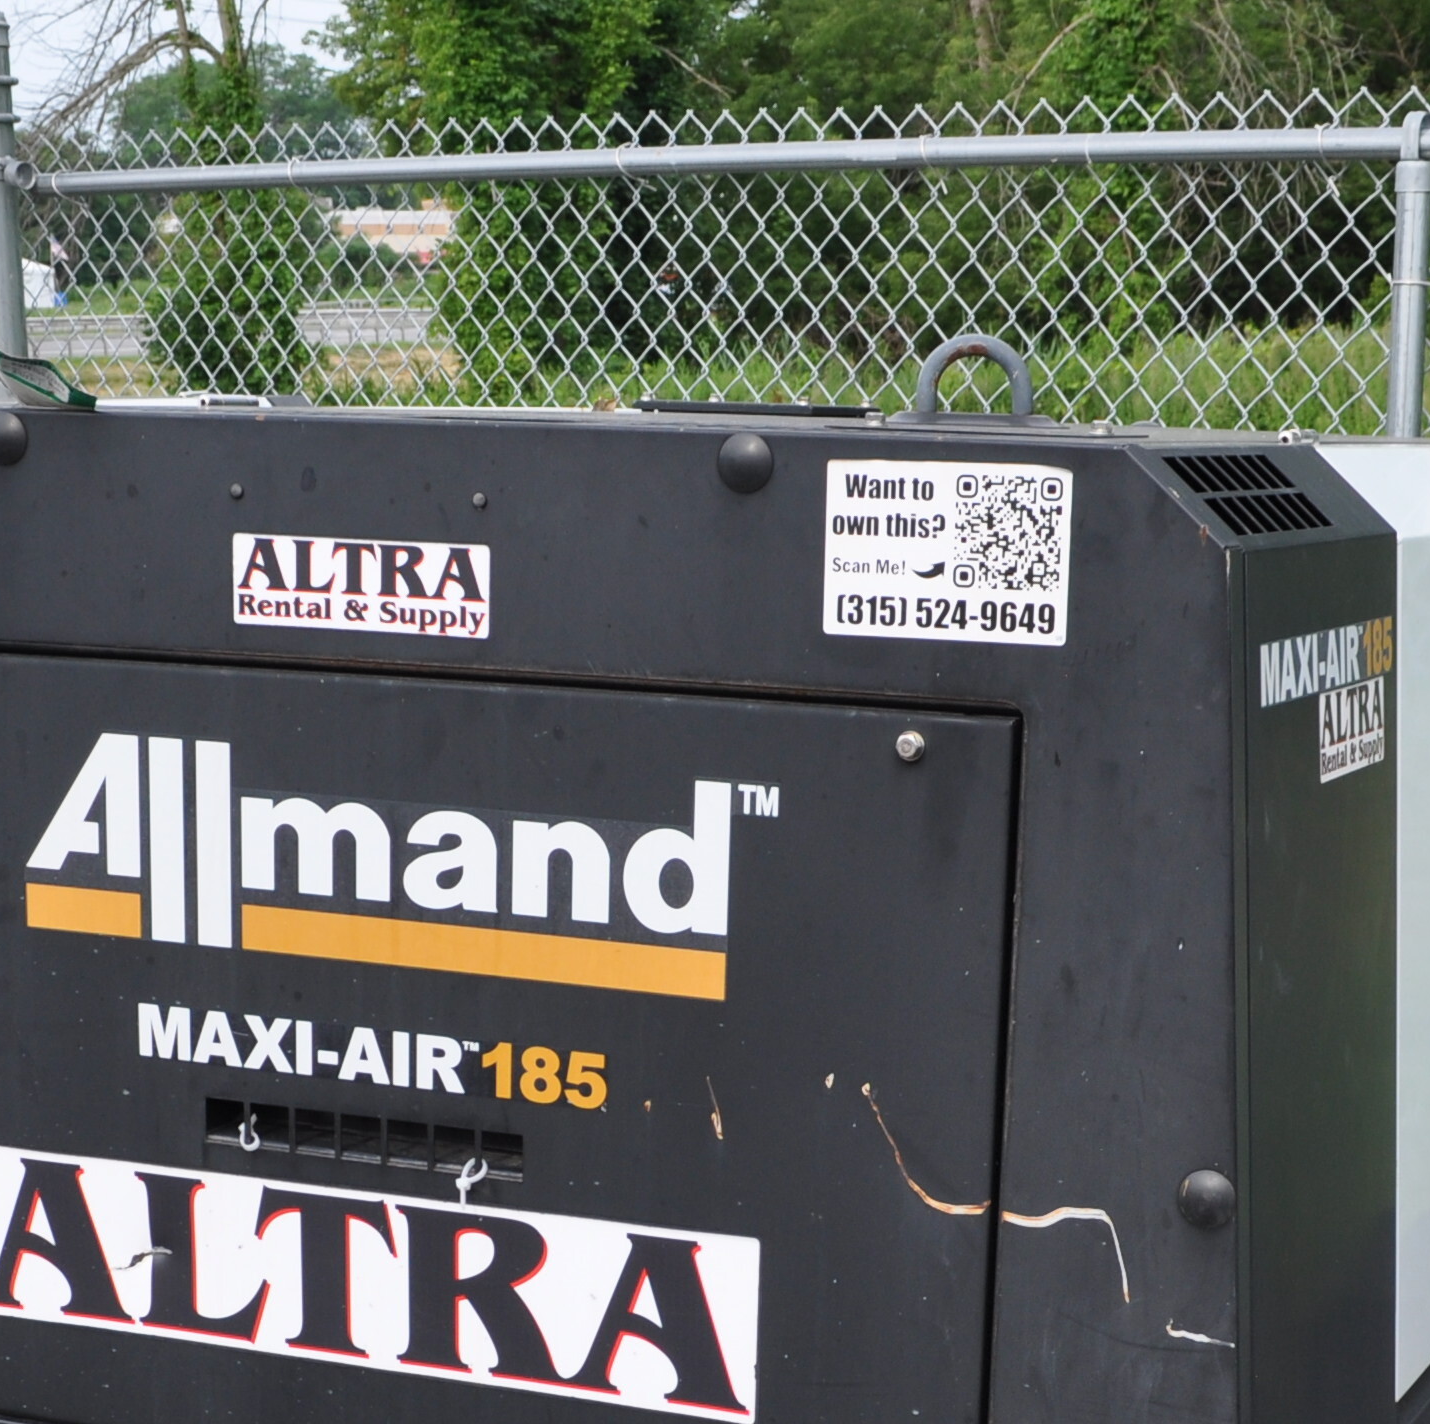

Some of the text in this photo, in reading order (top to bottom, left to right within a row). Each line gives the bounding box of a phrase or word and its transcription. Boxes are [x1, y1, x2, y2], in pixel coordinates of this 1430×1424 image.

[845, 474, 934, 501] Want to
[832, 513, 946, 539] own this?
[238, 537, 486, 603] ALTRA
[832, 557, 906, 575] Scan Me!
[238, 594, 485, 636] Rental & Supply
[836, 594, 1055, 635] (315) 524-9649
[1260, 616, 1392, 708] MAXI-AIR 185
[1321, 680, 1383, 749] ALTRA
[1321, 745, 1347, 776] Rental
[1359, 733, 1383, 764] Supply
[26, 732, 732, 949] Allmand
[137, 1002, 465, 1094] MAXI-AIR
[482, 1042, 608, 1110] 185
